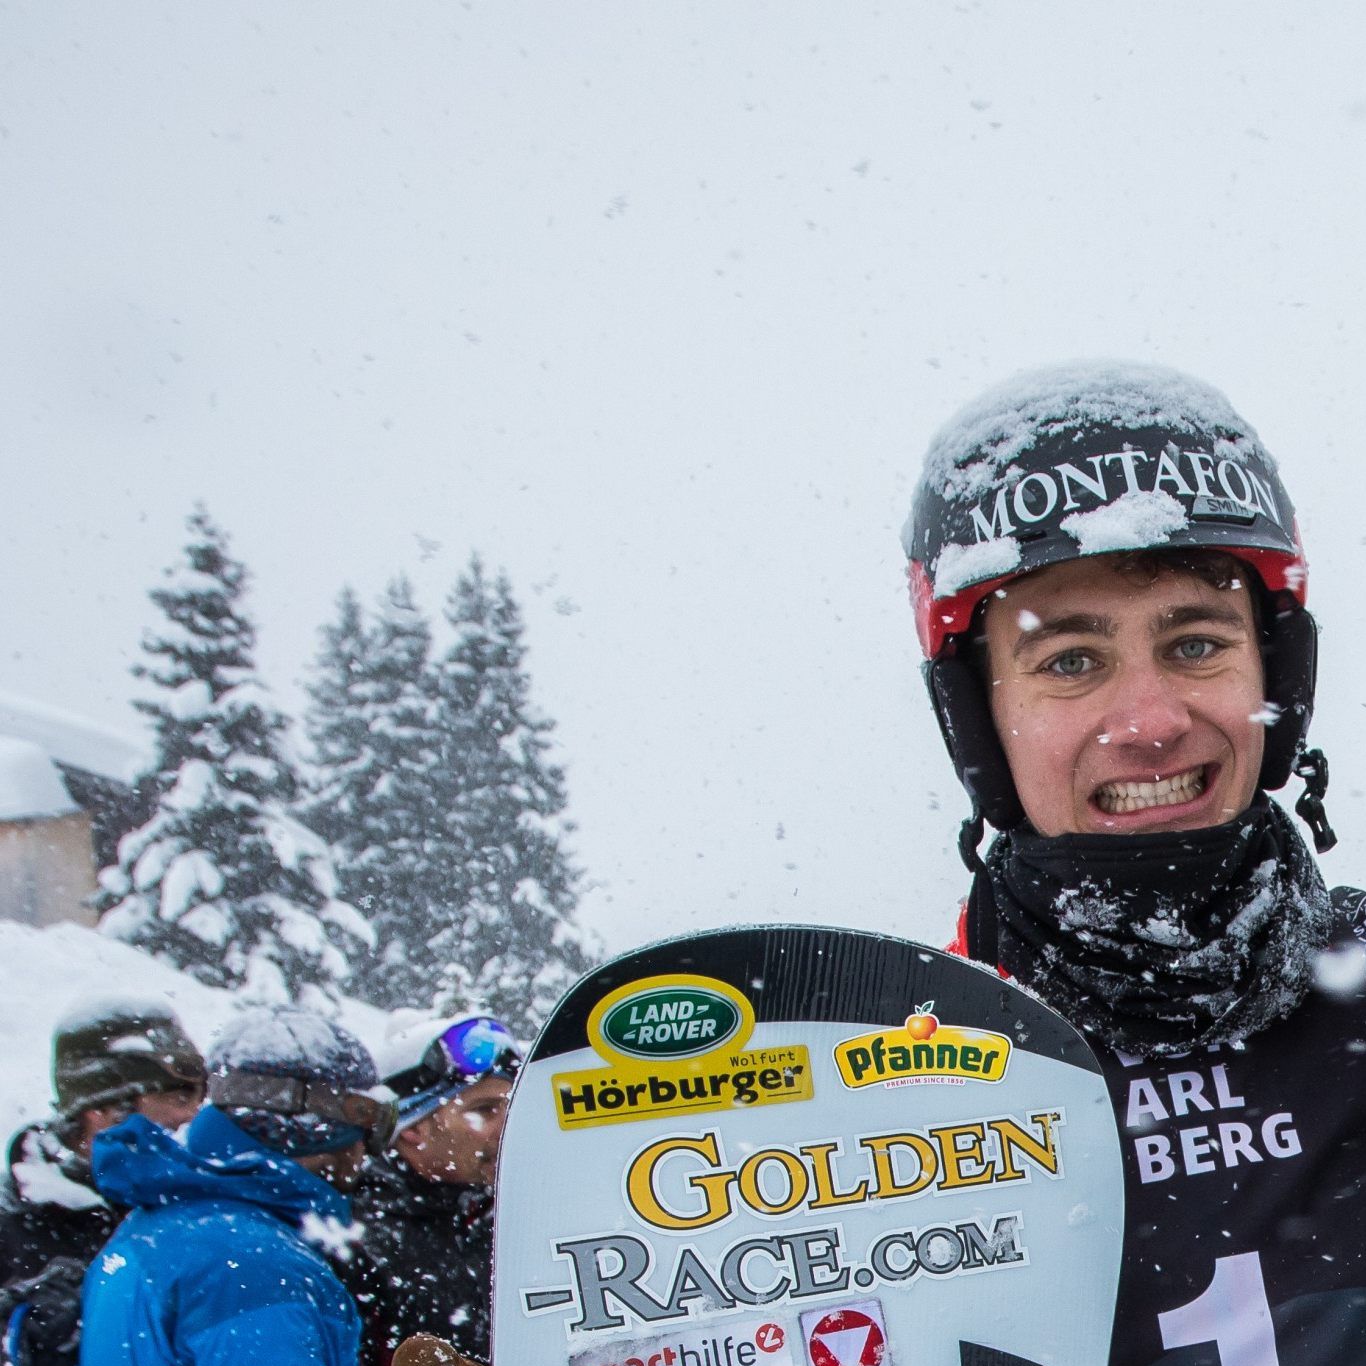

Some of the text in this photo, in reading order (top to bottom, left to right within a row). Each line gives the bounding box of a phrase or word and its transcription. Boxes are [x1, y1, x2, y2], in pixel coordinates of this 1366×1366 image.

[969, 449, 1281, 544] MONTAFON
[559, 1064, 804, 1115] Hörburger
[729, 1050, 796, 1068] Wolfurt
[886, 1077, 921, 1088] PREMIUM
[1126, 1064, 1246, 1128] ARL
[626, 1113, 1062, 1231] GOLDEN
[1134, 1112, 1303, 1184] BERG
